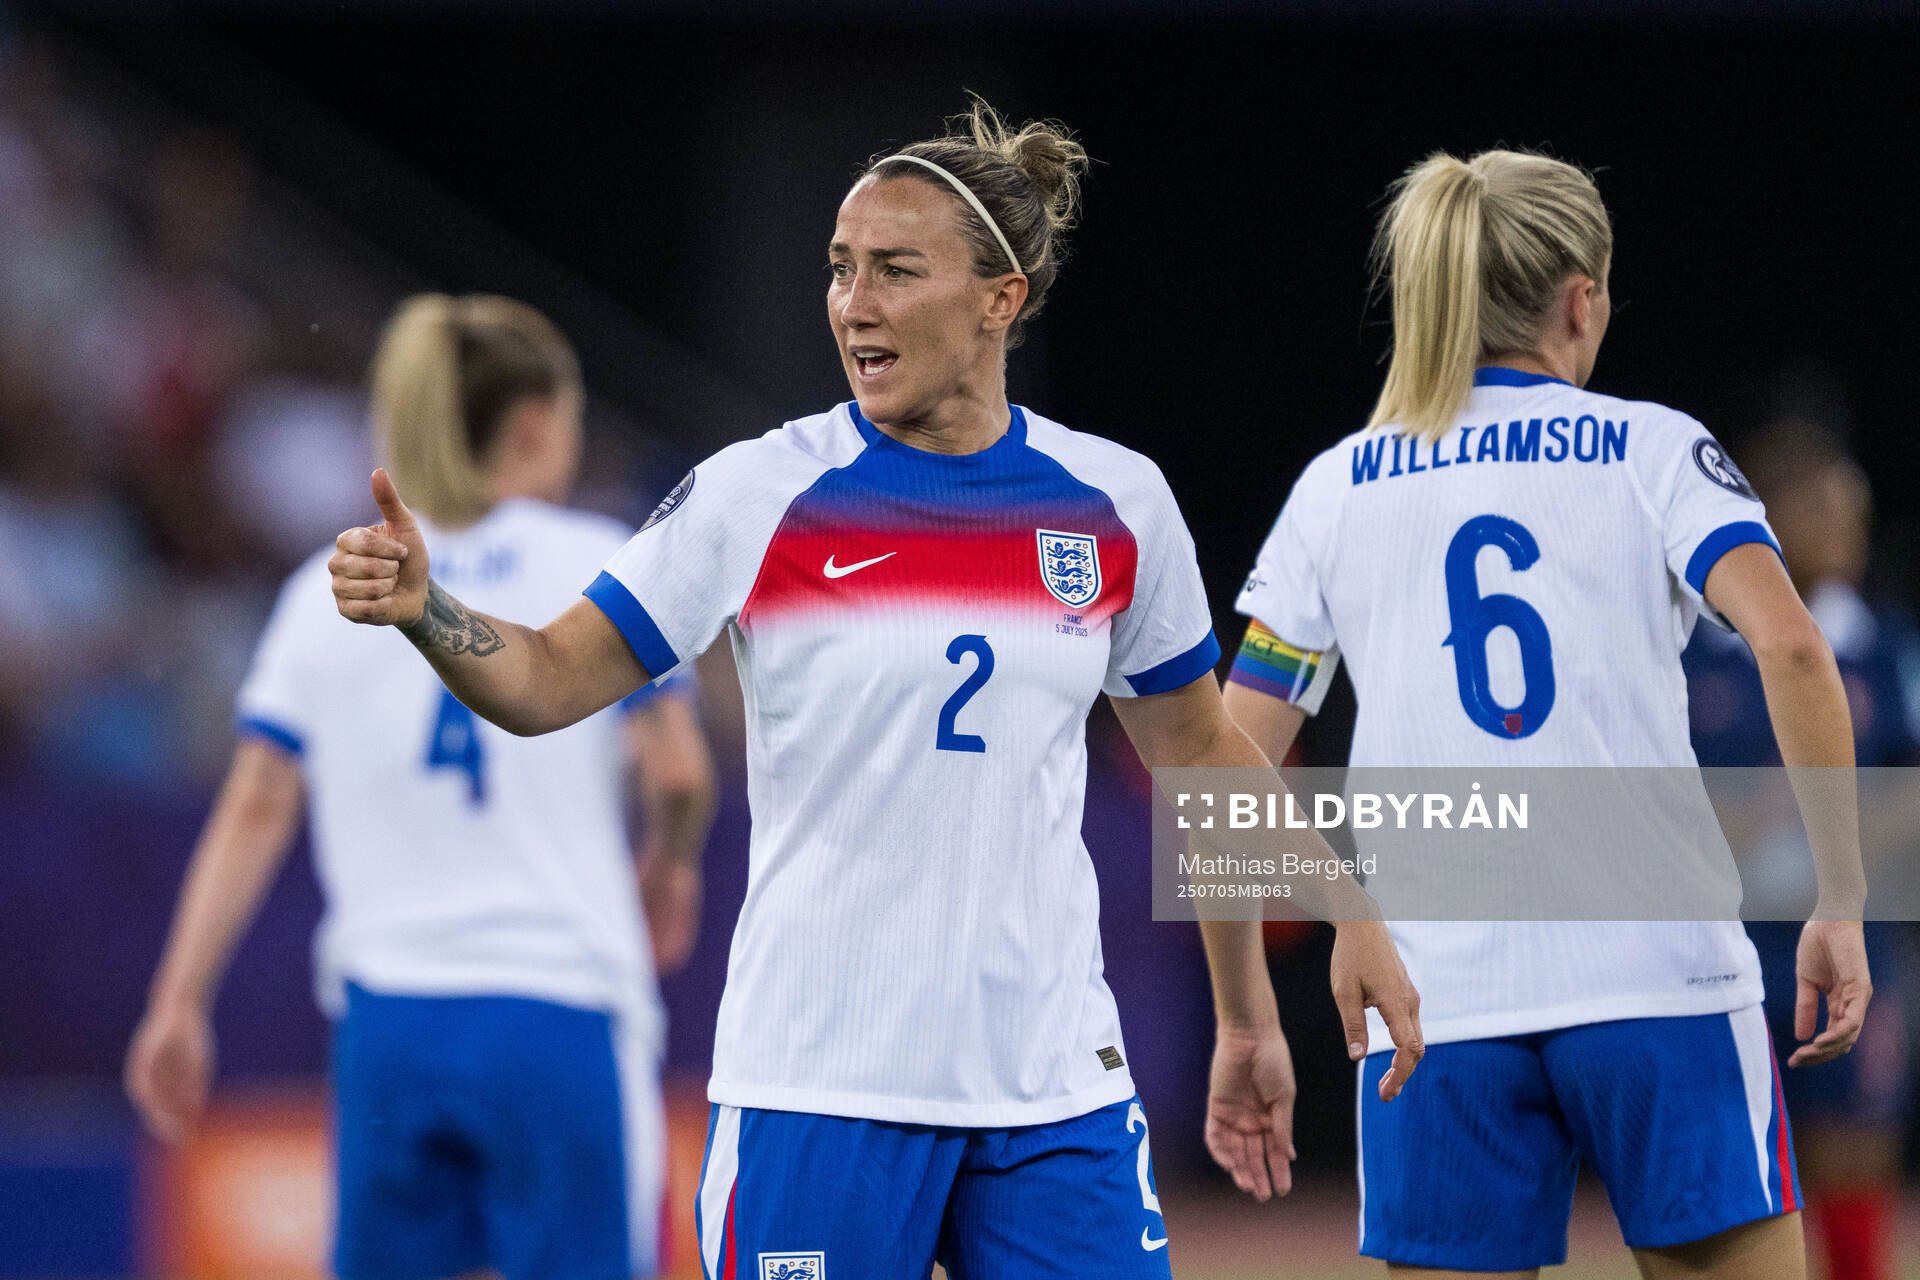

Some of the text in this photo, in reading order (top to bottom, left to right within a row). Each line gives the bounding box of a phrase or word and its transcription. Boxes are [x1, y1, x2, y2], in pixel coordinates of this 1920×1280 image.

[1352, 414, 1628, 485] WILLIAMSON
[1061, 624, 1074, 634] JULY
[1063, 613, 1083, 625] FRANCE
[1441, 514, 1556, 740] 6
[936, 634, 995, 753] 2
[1126, 1102, 1163, 1217] 2
